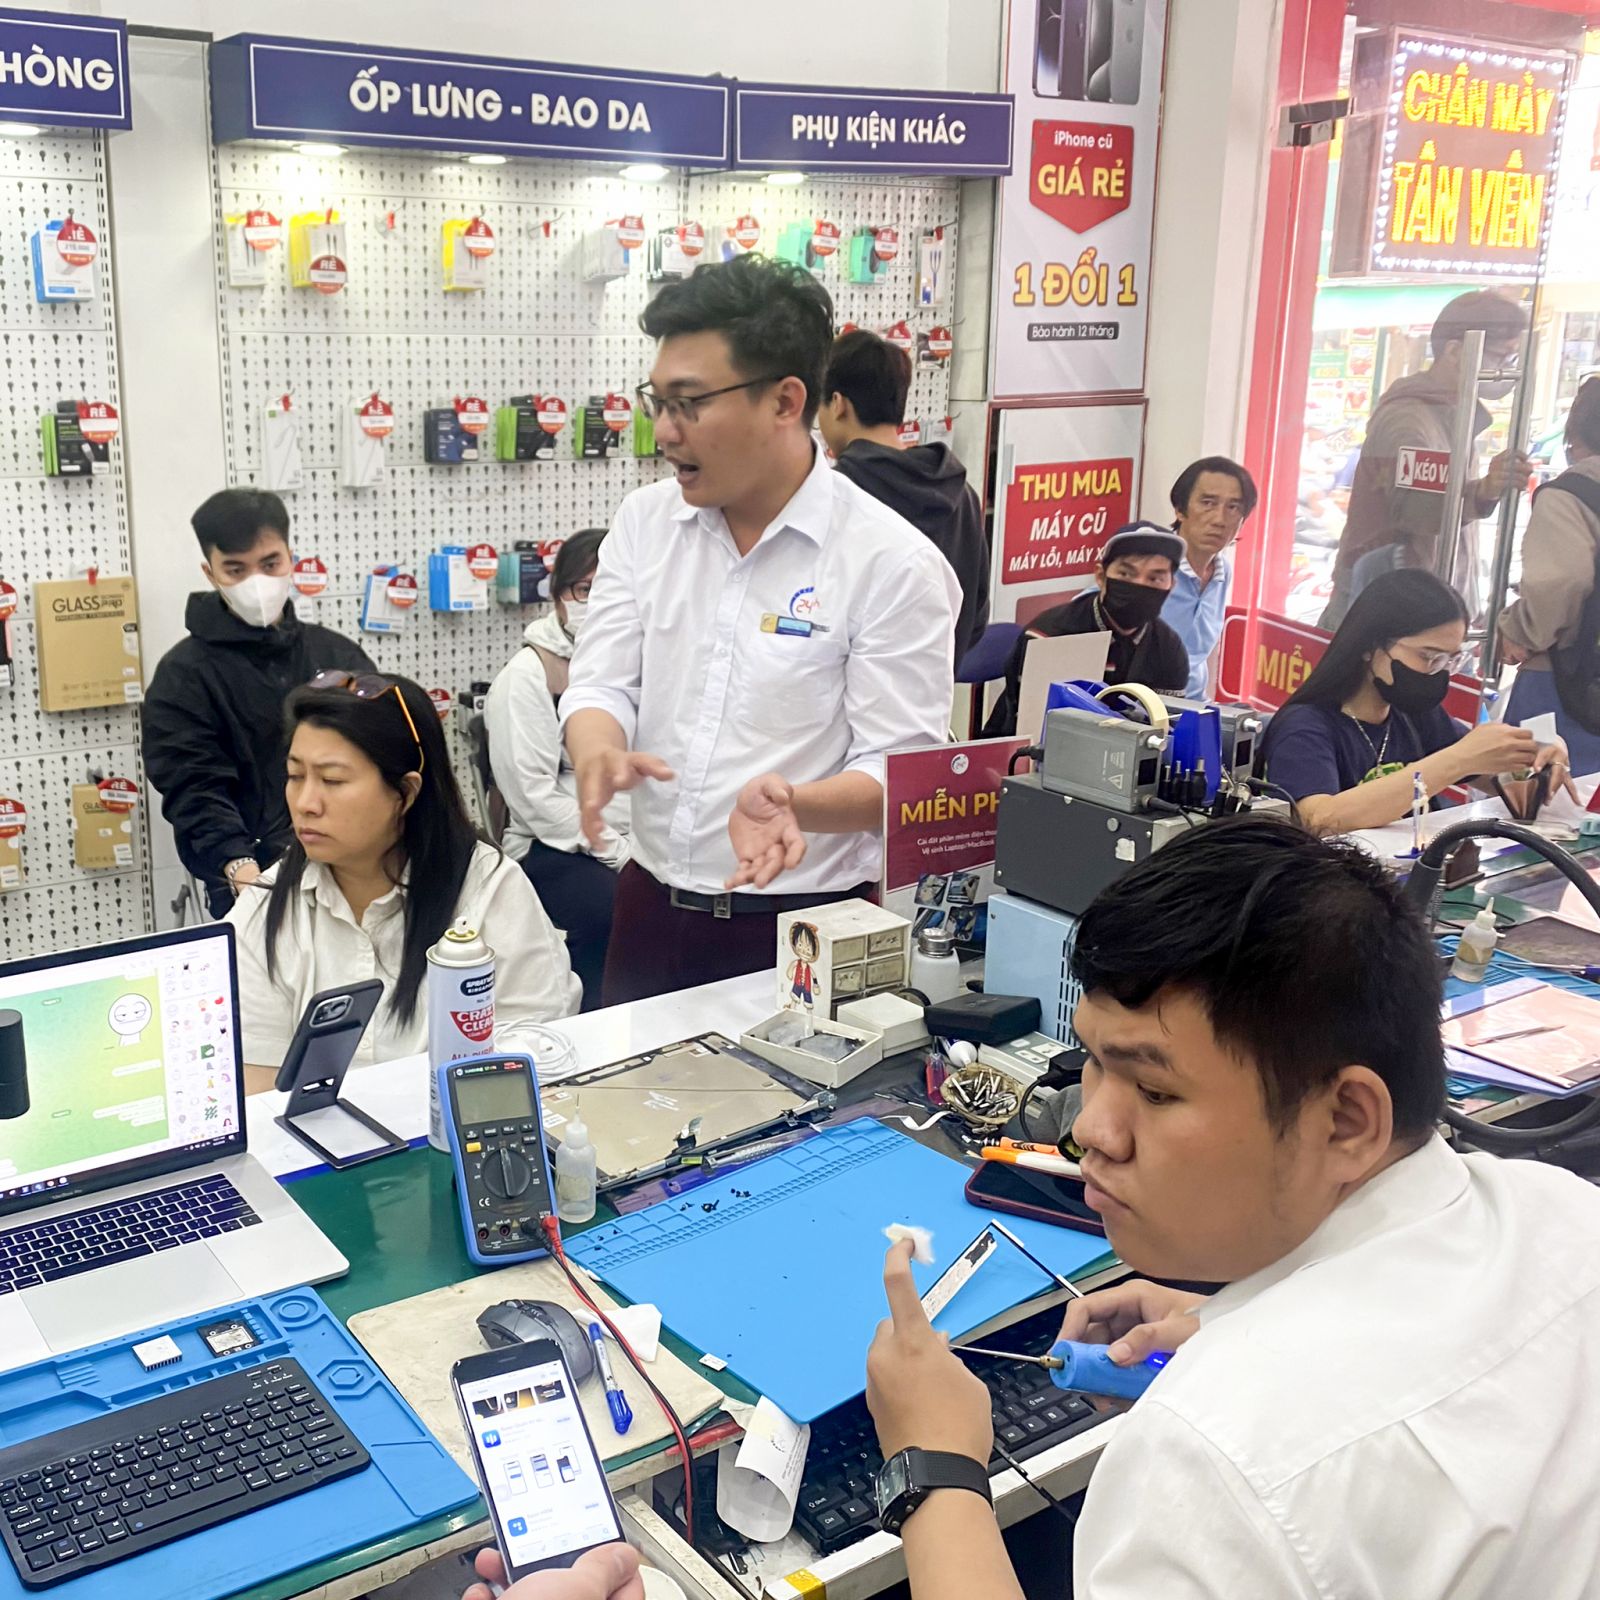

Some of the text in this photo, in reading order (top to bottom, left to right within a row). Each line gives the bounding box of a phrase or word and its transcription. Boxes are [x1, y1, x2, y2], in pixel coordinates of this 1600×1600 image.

[0, 44, 114, 91] HÒNG
[350, 65, 401, 113] ỐP
[412, 81, 502, 122] LƯNG
[532, 93, 599, 129] BAO
[608, 100, 651, 133] DA
[792, 110, 966, 149] PHỤ KIỆN KHÁC
[1054, 130, 1113, 149] iPhone cũ
[1037, 157, 1126, 198] GIÁ RẺ
[1468, 149, 1545, 248] VIÊN
[1013, 246, 1138, 306] 1 ĐỔI 1
[1078, 325, 1088, 337] 12
[1019, 468, 1122, 502] THU MUA
[1414, 457, 1438, 482] KÉO
[1029, 506, 1107, 541] MÁY CŨ
[1009, 551, 1038, 572] MÁY
[1065, 545, 1093, 565] MÁY
[52, 595, 100, 613] GLASS
[901, 787, 967, 826] MIỄN
[479, 1197, 490, 1207] CE
